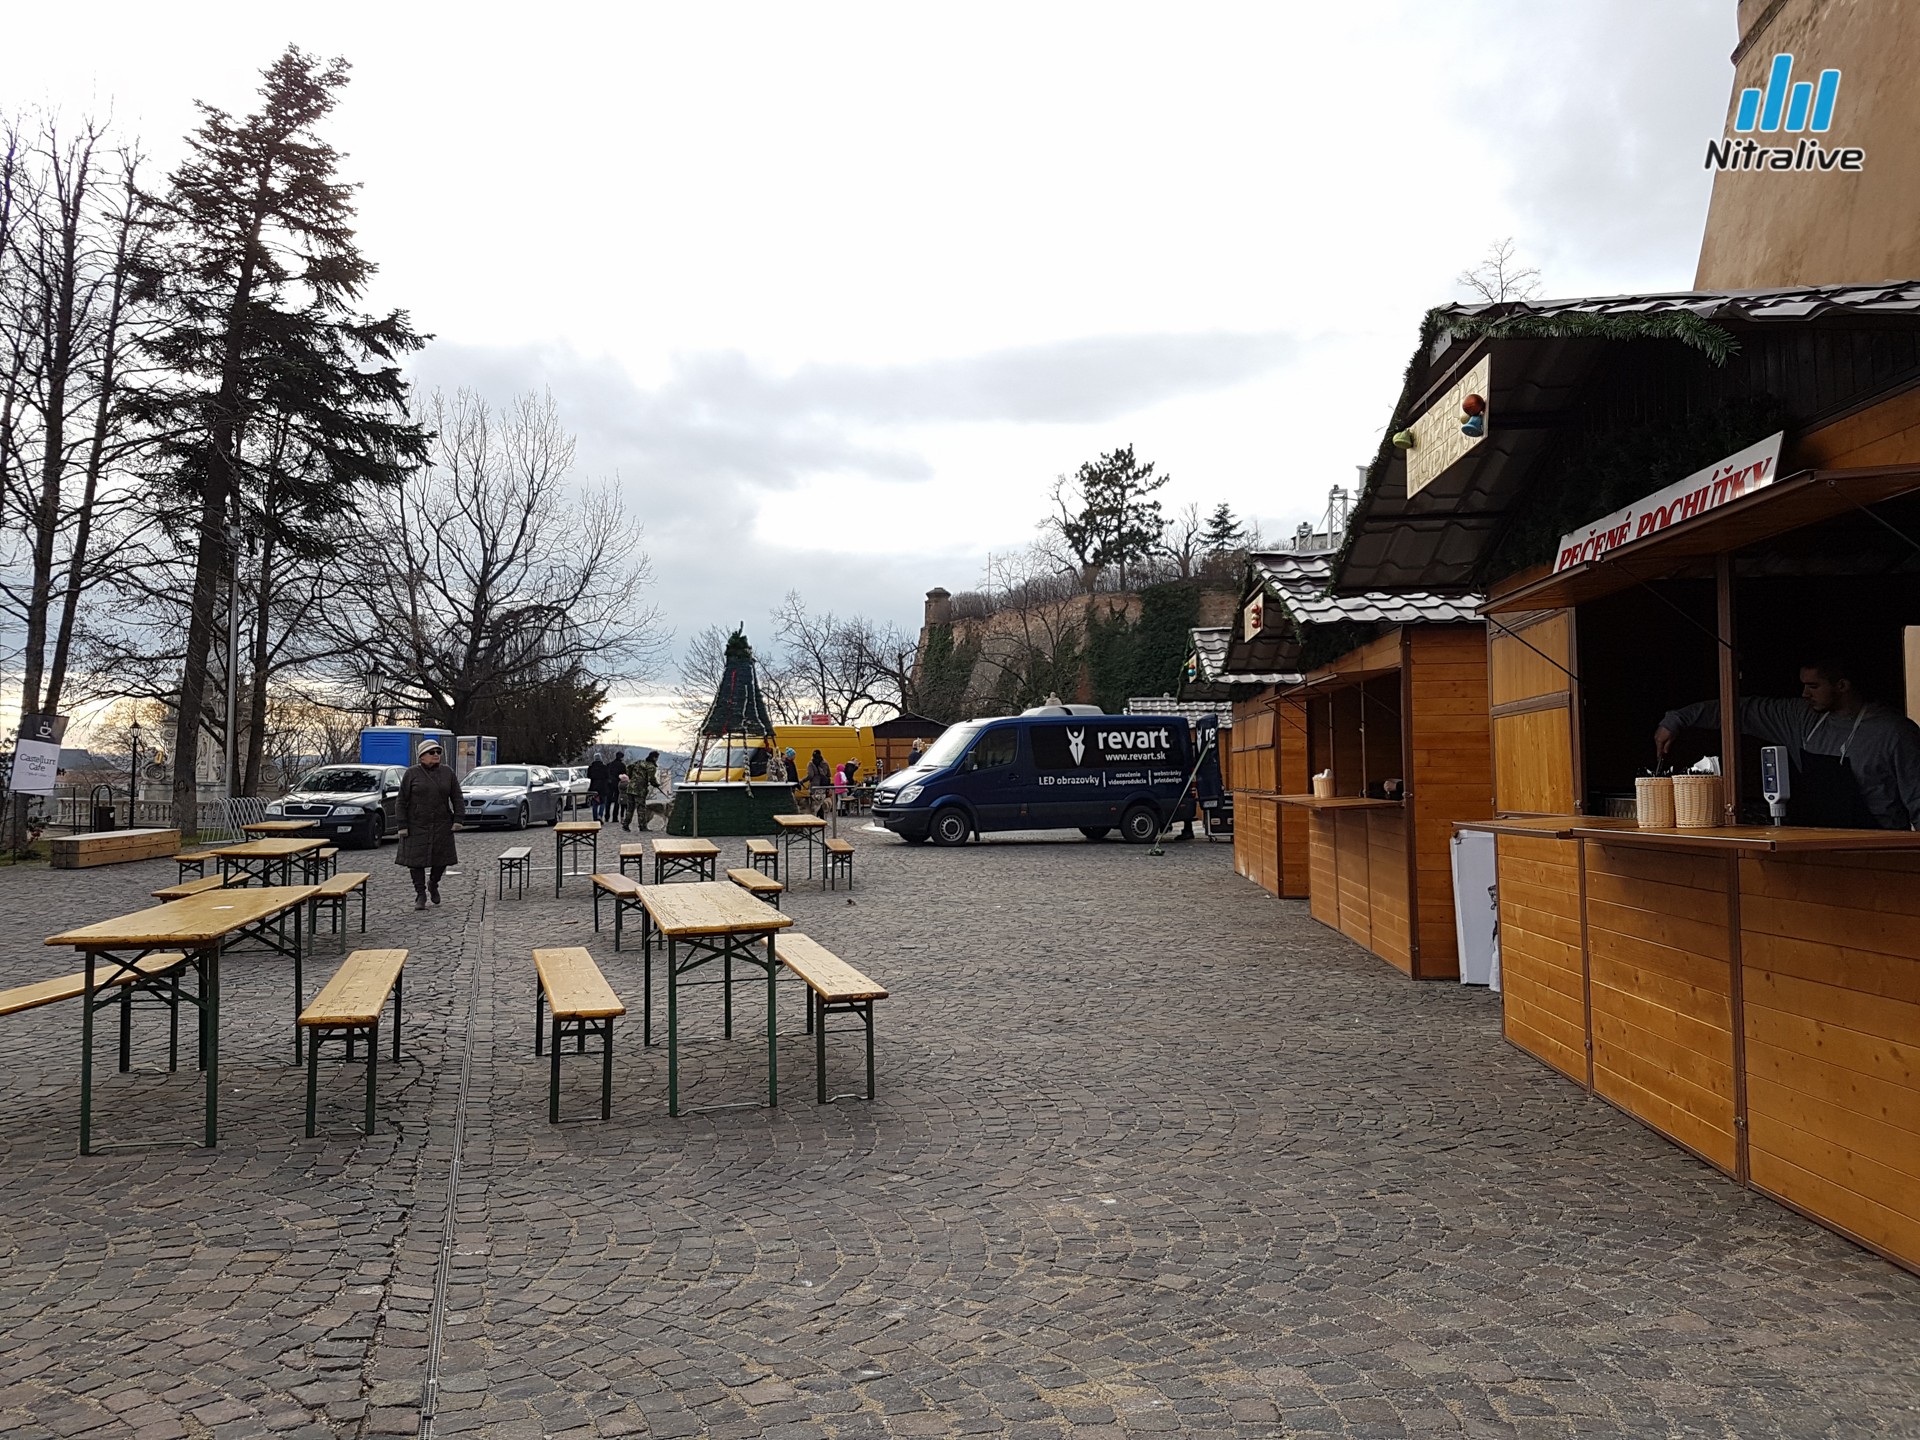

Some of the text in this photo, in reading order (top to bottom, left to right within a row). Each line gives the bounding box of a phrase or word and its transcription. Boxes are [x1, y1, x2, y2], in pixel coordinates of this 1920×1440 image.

[1558, 511, 1632, 572] PEČENÉ
[1097, 727, 1171, 750] revart
[1105, 752, 1166, 762] www.revart.sk
[1038, 775, 1100, 786] LED obrazovky
[1108, 777, 1147, 786] videoprodukcia
[1153, 777, 1183, 785] printdesign
